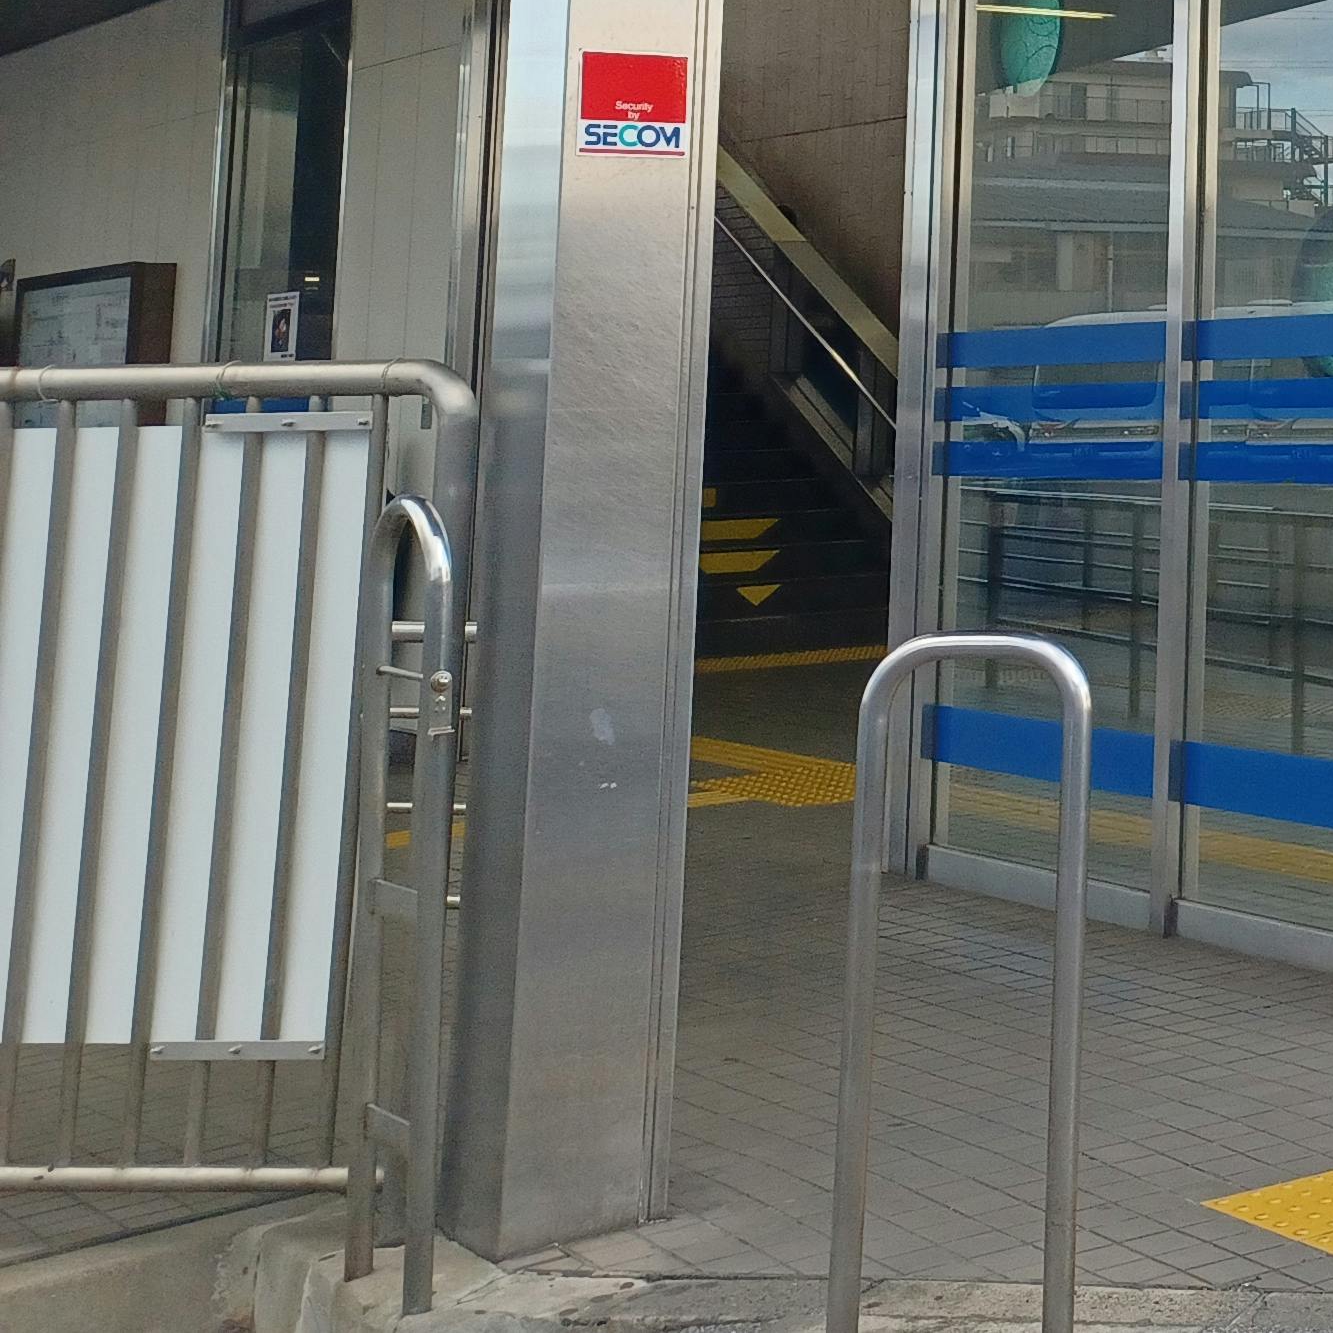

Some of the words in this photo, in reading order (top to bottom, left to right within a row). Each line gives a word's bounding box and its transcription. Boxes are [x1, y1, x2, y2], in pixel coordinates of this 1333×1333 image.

[615, 101, 654, 113] Security
[627, 111, 641, 121] by
[584, 123, 681, 149] SECOM
